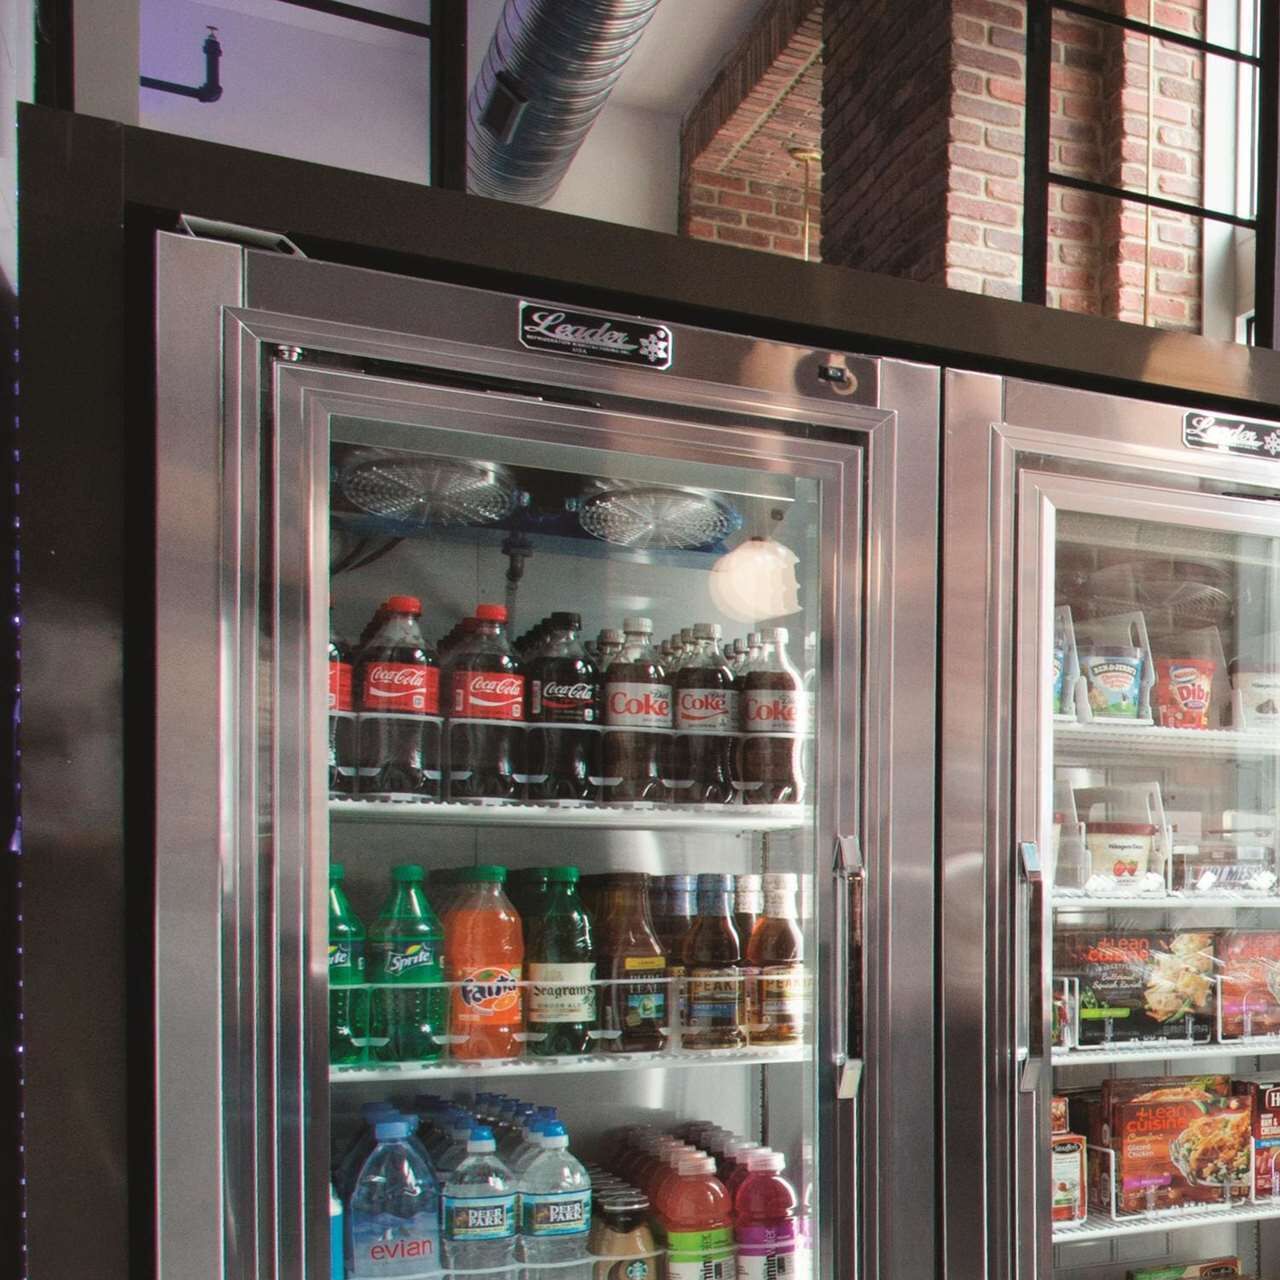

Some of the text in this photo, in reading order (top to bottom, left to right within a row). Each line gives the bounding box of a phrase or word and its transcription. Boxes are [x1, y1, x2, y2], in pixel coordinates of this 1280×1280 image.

[525, 312, 637, 349] Leader
[609, 691, 669, 716] Coke
[681, 694, 726, 711] Coke
[390, 950, 431, 970] Sprite
[467, 1207, 503, 1219] DEER
[548, 1200, 583, 1213] DEER
[467, 1215, 504, 1228] PARK
[548, 1210, 583, 1223] PARK
[370, 1236, 433, 1260] evian
